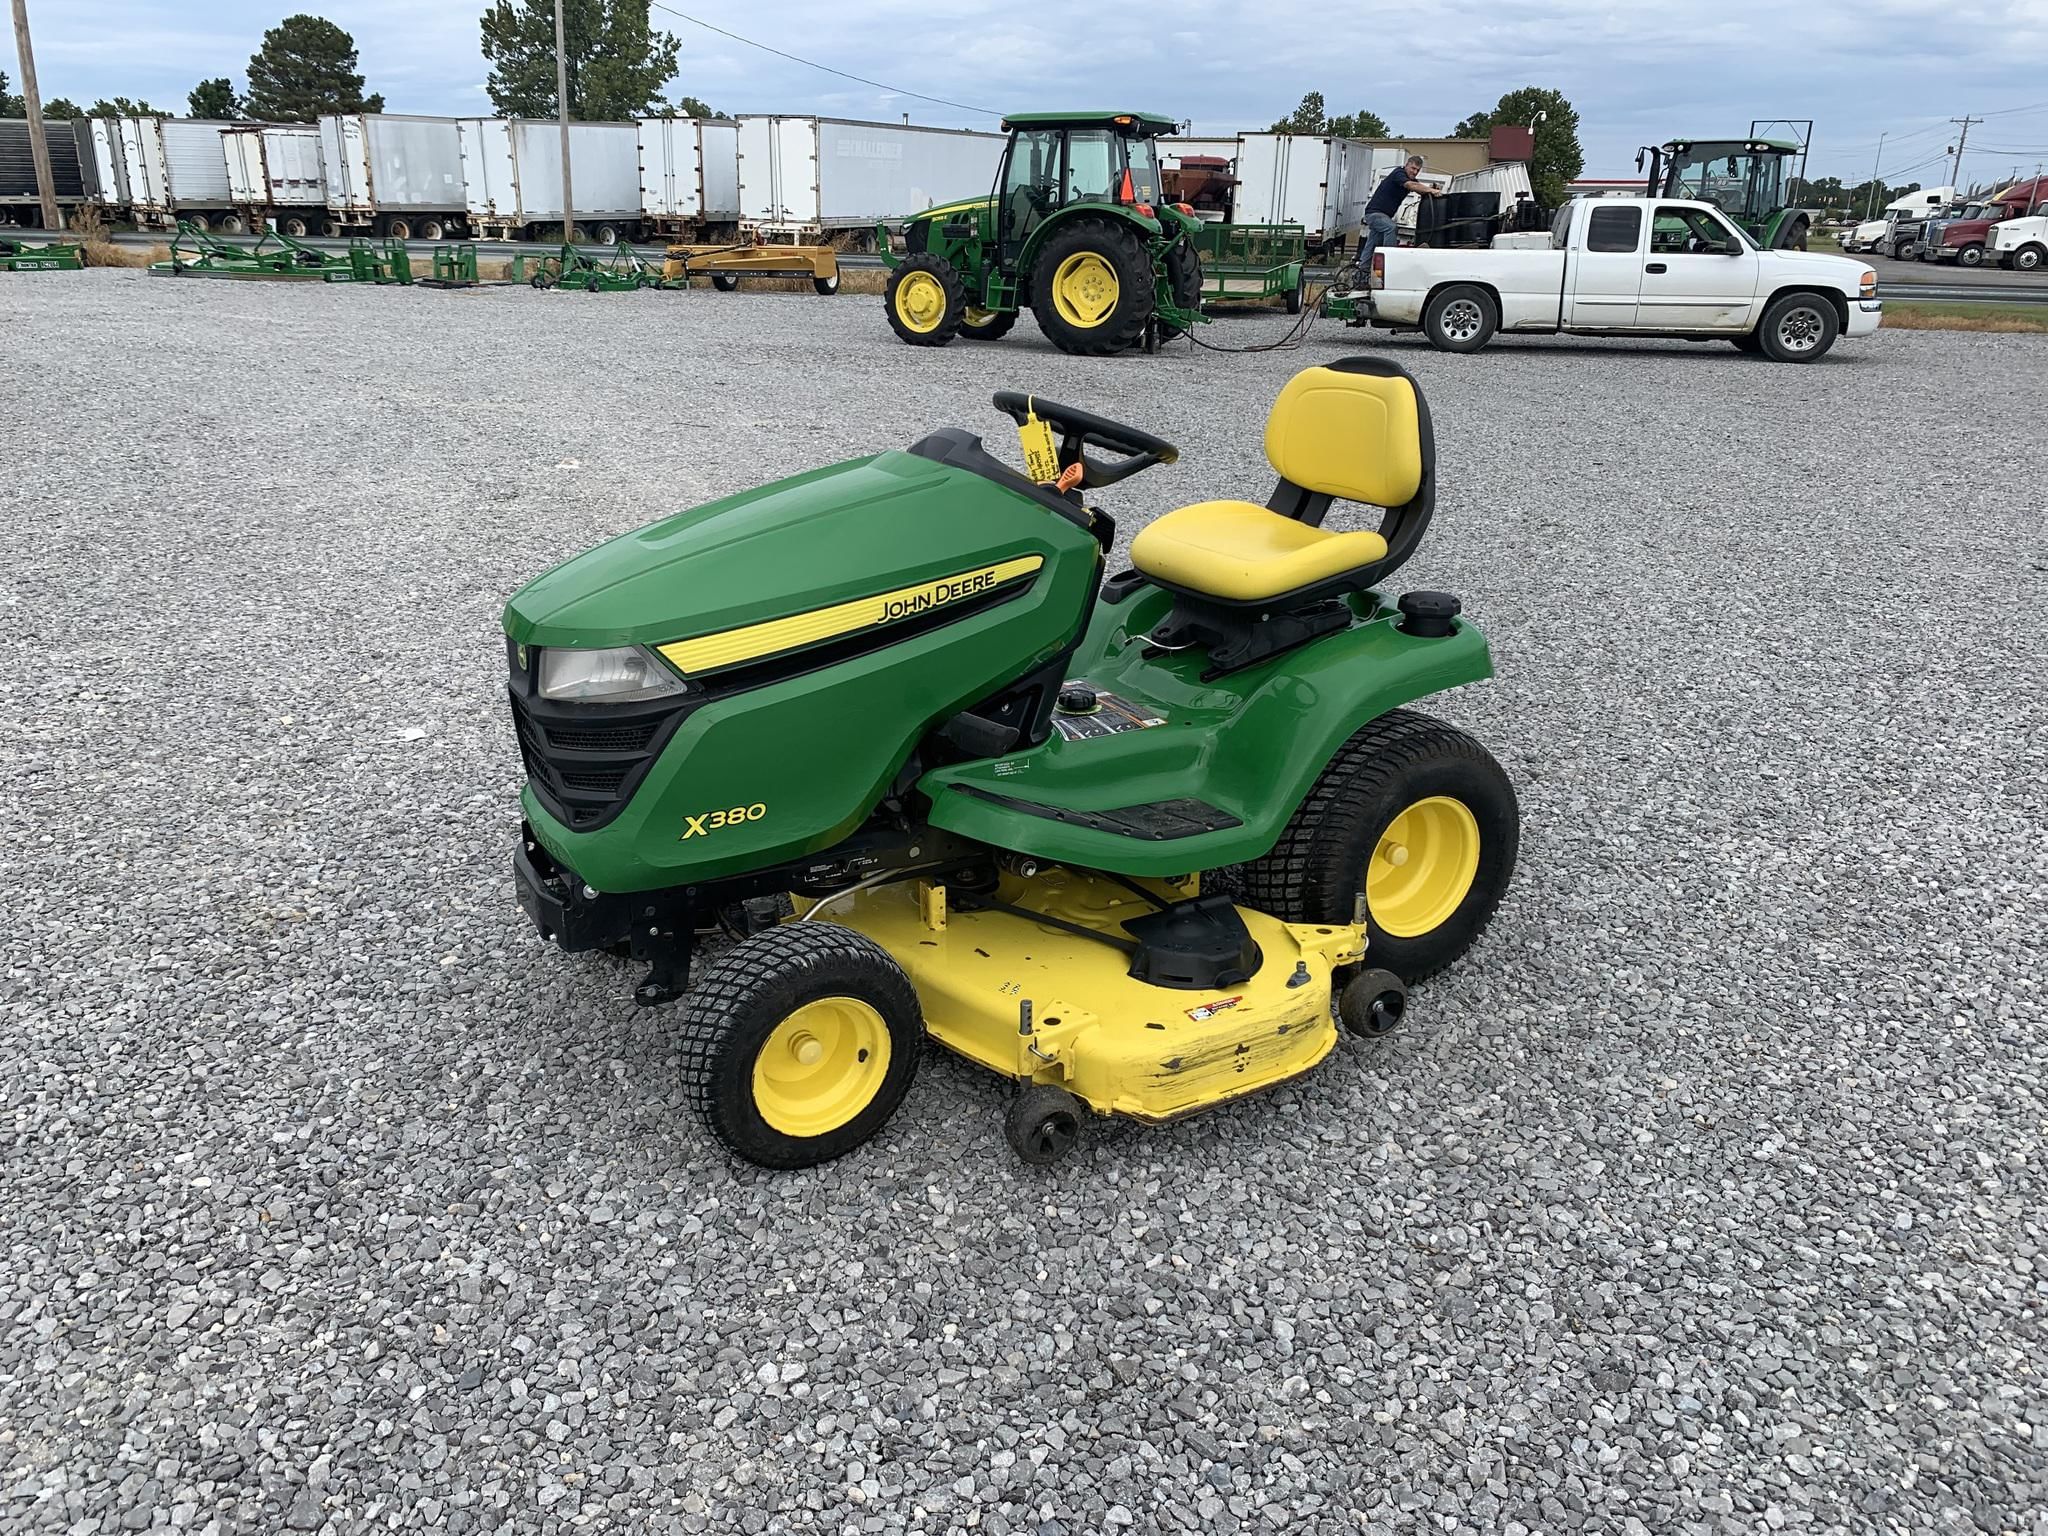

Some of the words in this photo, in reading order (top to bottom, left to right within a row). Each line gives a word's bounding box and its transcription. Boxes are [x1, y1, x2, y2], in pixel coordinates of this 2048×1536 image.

[878, 592, 931, 622] JOHN
[935, 570, 996, 604] DEERE
[679, 802, 768, 841] X380
